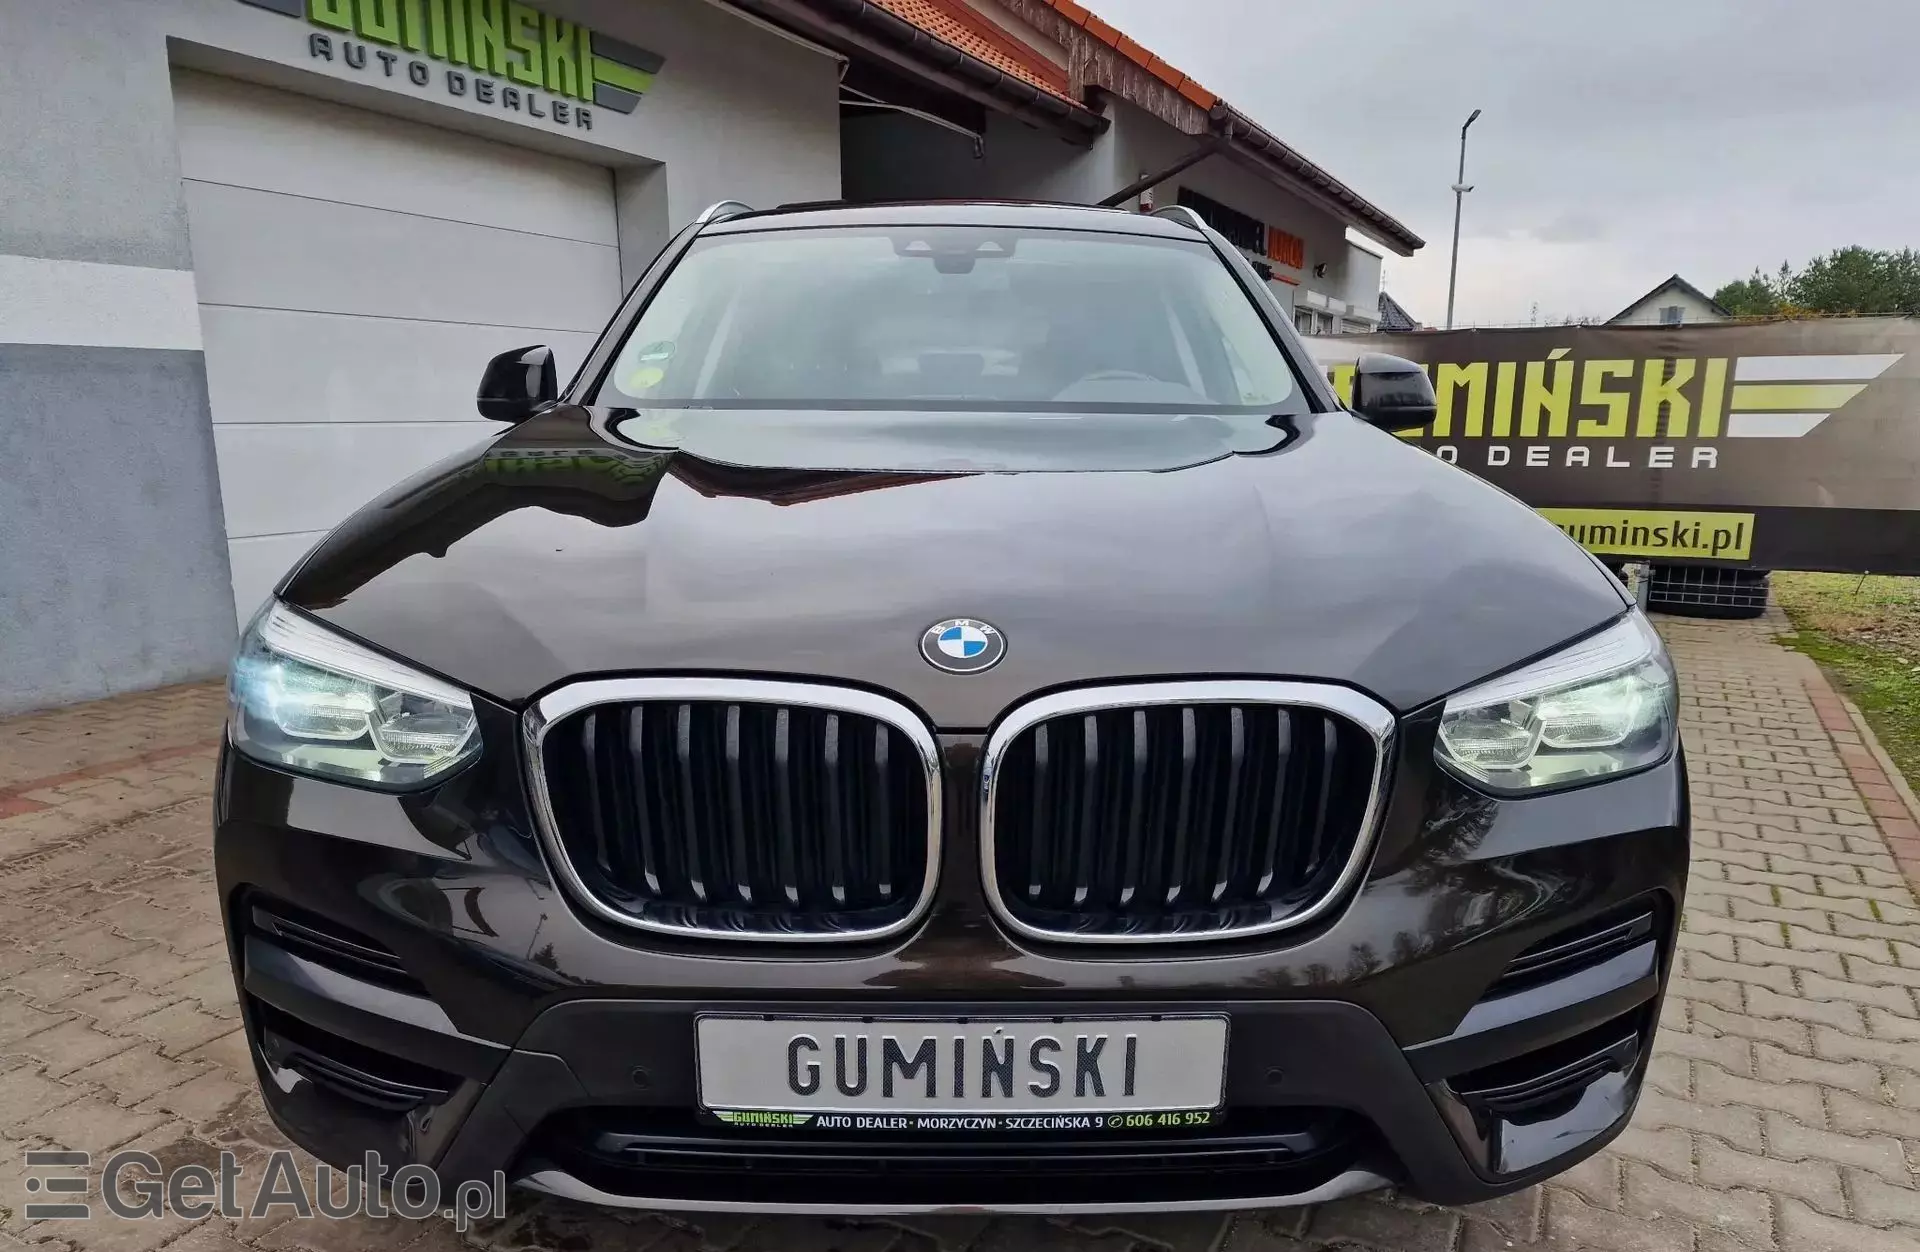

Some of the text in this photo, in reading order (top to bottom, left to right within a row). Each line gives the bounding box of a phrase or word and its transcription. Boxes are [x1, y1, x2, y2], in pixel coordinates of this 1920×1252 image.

[309, 33, 593, 130] AUTO DEALER
[1333, 347, 1729, 438] MIŃSKI
[1487, 445, 1718, 469] DEALER
[786, 1027, 1138, 1097] GUMIŃSKI
[733, 1111, 793, 1124] GUMIŃSKI
[817, 1111, 1210, 1129] AUTO DEALER MORZYCZYN SZCZECIŃSKA 9 606 416 952
